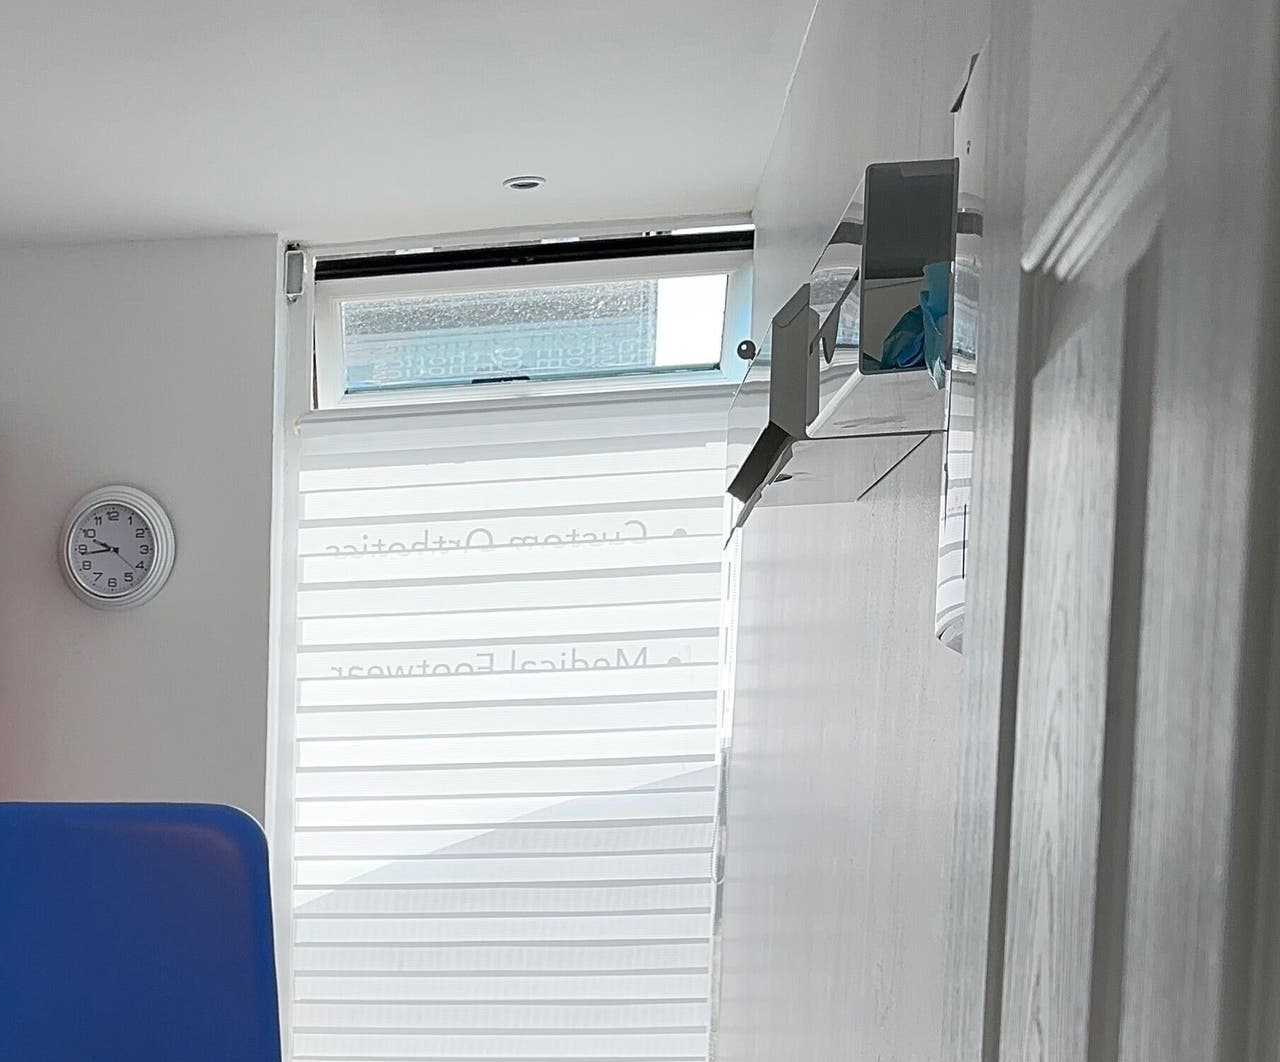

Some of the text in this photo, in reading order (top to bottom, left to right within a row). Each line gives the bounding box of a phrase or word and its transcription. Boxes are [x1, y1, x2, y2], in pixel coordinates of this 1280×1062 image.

[94, 516, 102, 525] 11
[107, 511, 120, 521] 12
[83, 528, 96, 539] 10
[135, 529, 145, 538] 2
[78, 544, 88, 554] 9
[140, 545, 149, 554] 3
[82, 561, 92, 570] 8
[135, 561, 145, 569] 4
[93, 572, 103, 582] 7
[124, 572, 133, 582] 5
[108, 578, 117, 587] 6
